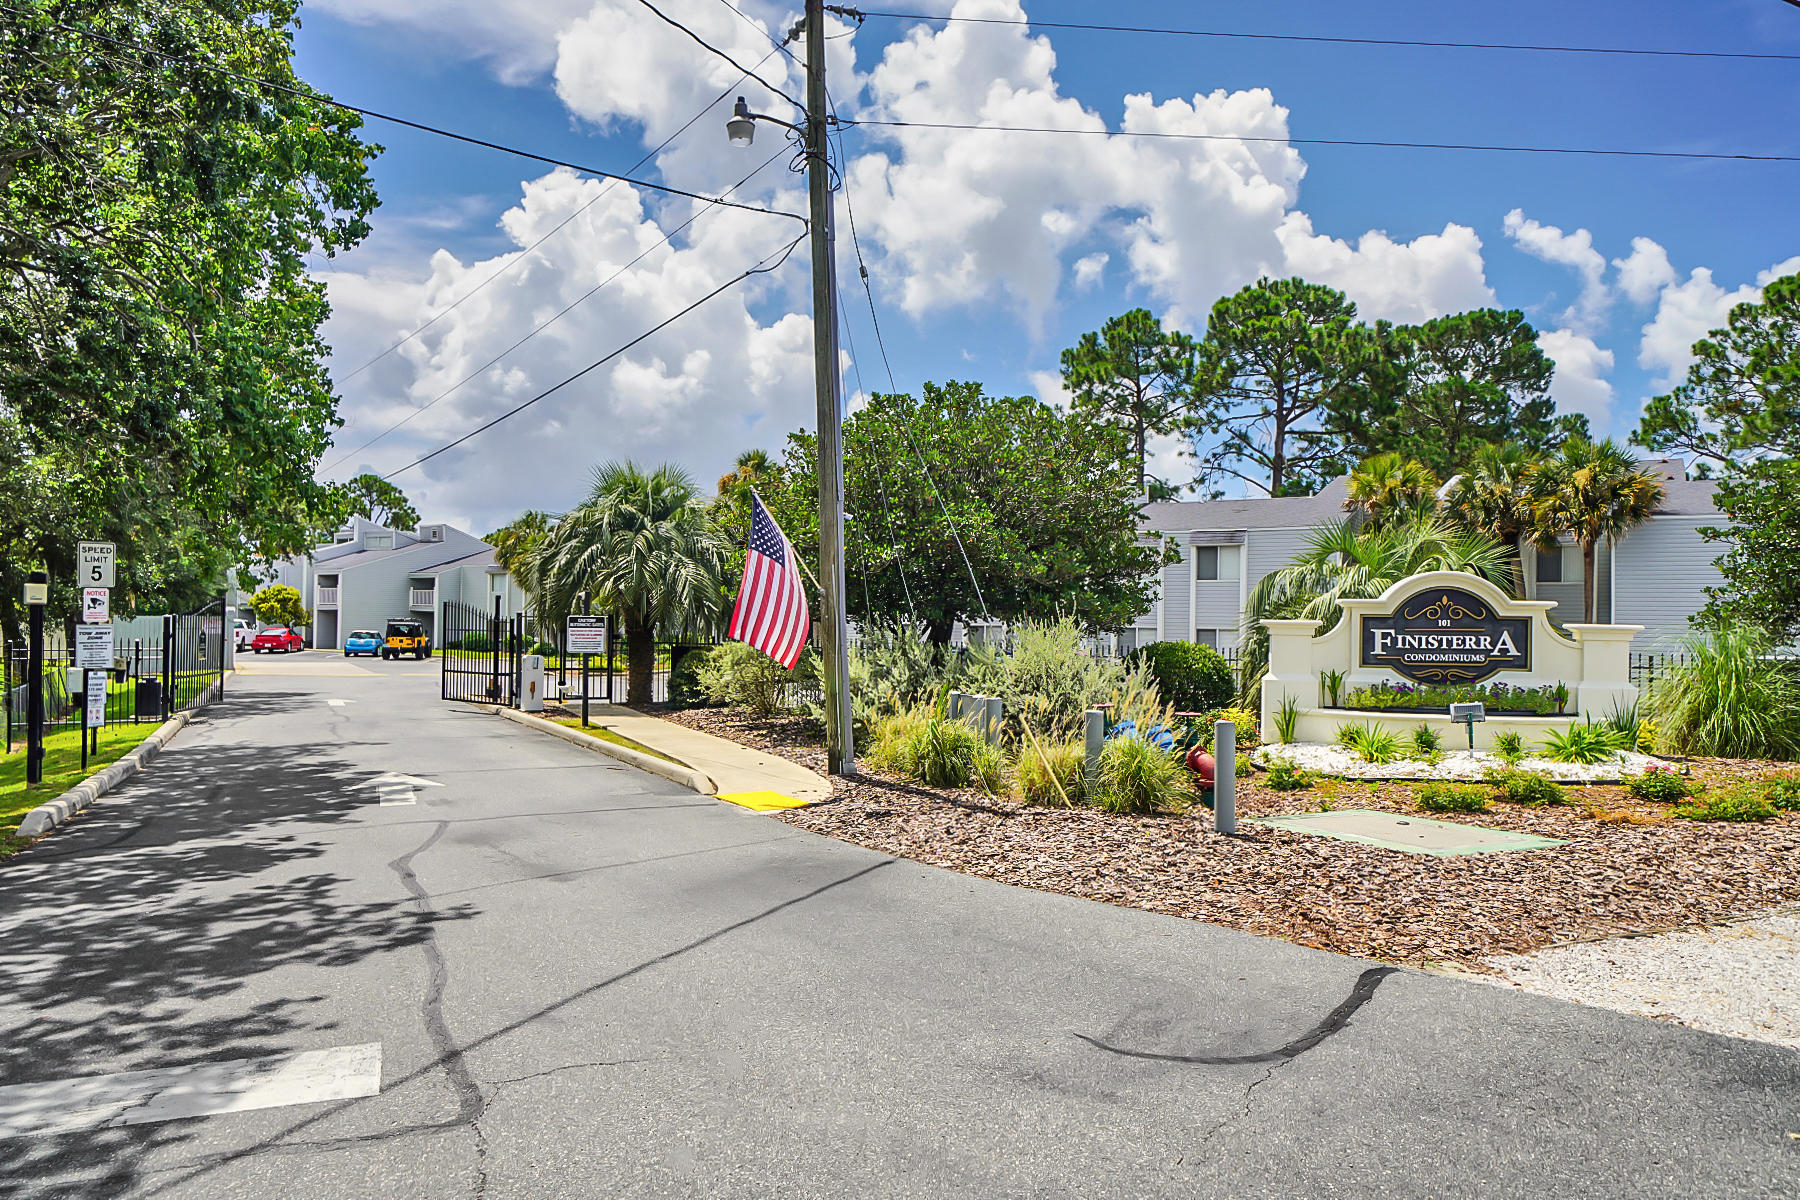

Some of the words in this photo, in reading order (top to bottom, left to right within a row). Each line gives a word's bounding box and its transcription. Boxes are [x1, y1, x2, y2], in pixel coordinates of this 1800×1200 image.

[82, 546, 112, 554] SPEED
[90, 565, 102, 581] 5
[1438, 619, 1451, 627] 101
[1370, 628, 1522, 656] FINISTERRA
[1404, 653, 1485, 662] CONDOMINIUMS
